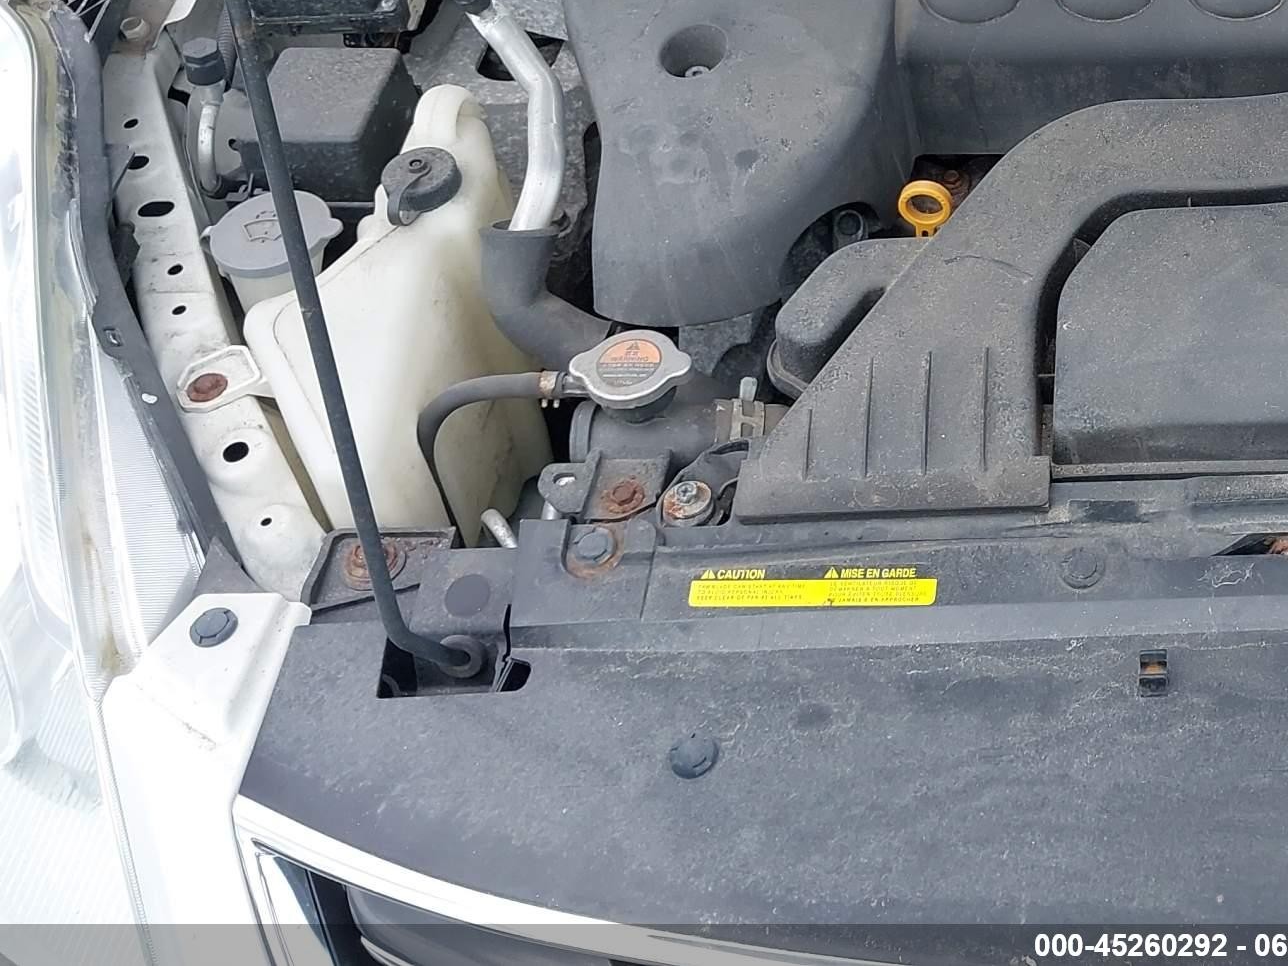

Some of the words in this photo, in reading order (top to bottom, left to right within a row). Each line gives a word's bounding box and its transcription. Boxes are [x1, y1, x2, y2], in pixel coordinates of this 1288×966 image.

[717, 569, 766, 579] CAUTION
[840, 568, 865, 579] MISE
[866, 568, 880, 579] EN
[881, 567, 917, 578] GARDE
